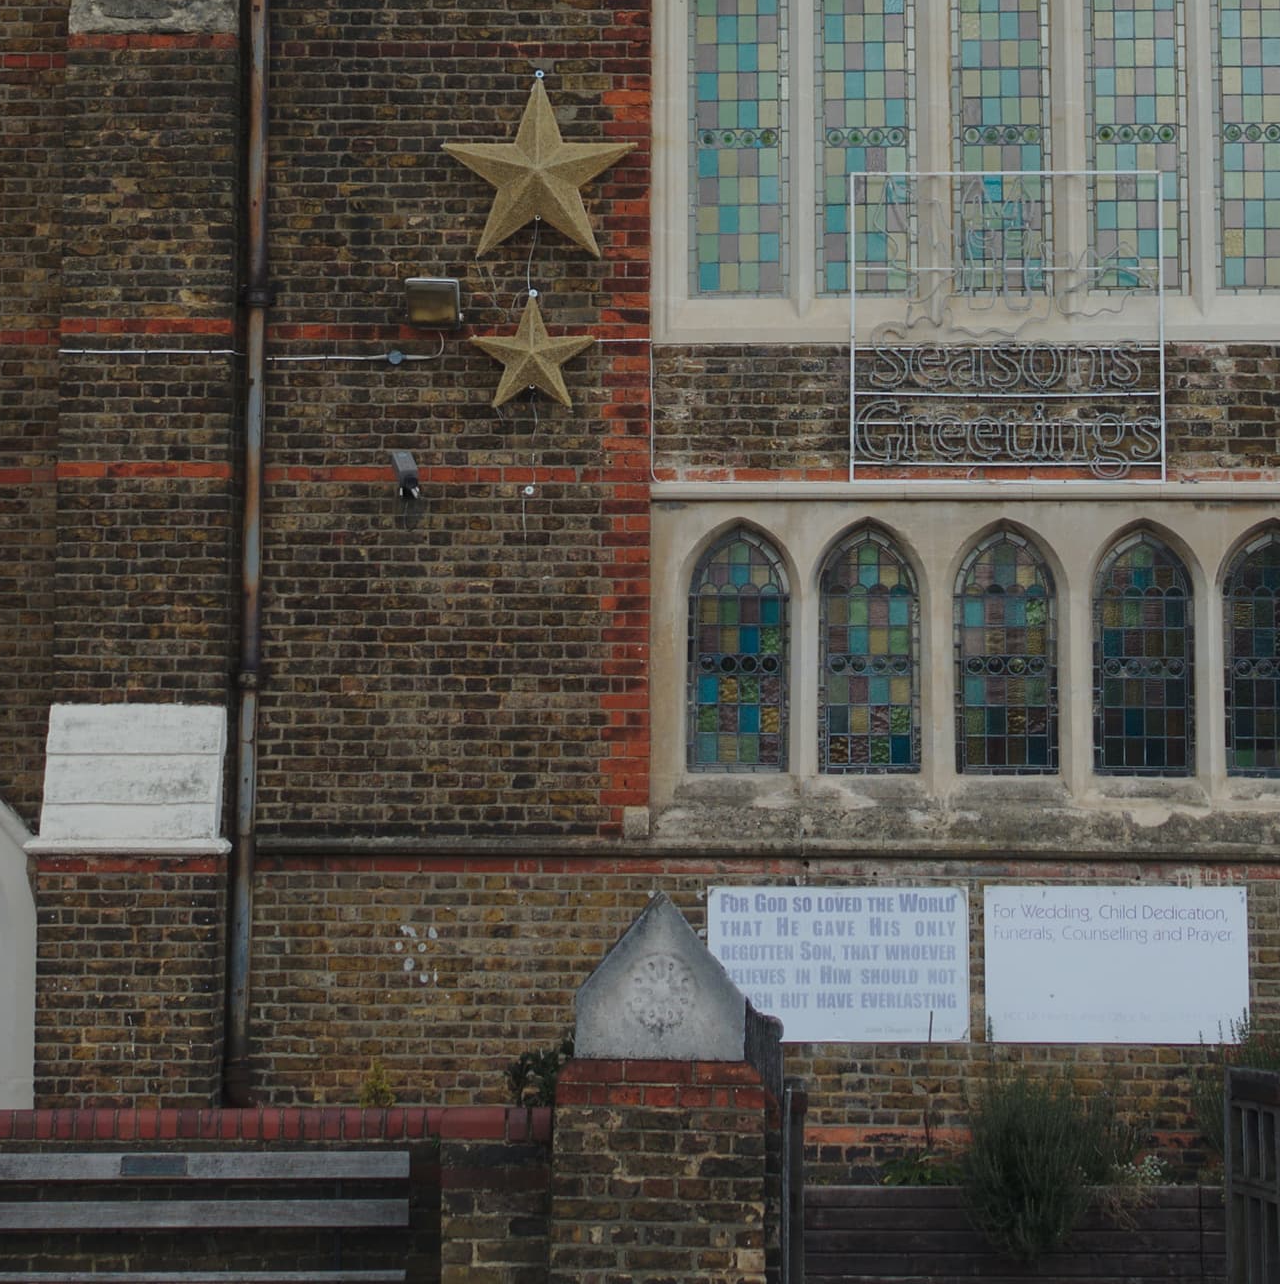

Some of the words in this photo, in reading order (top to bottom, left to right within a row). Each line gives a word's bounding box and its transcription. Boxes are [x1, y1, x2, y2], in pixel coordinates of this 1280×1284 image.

[869, 321, 1142, 390] Seasons
[856, 400, 1160, 479] Greetings
[993, 904, 1016, 918] For
[1021, 904, 1093, 922] Wedding,
[1098, 904, 1137, 920] Child
[1142, 904, 1228, 923] Dedication,
[993, 925, 1056, 943] Funerals,
[1062, 926, 1148, 945] Counselling
[1153, 926, 1182, 941] and
[1187, 927, 1233, 945] Prayer
[728, 968, 786, 985] ELIEVES
